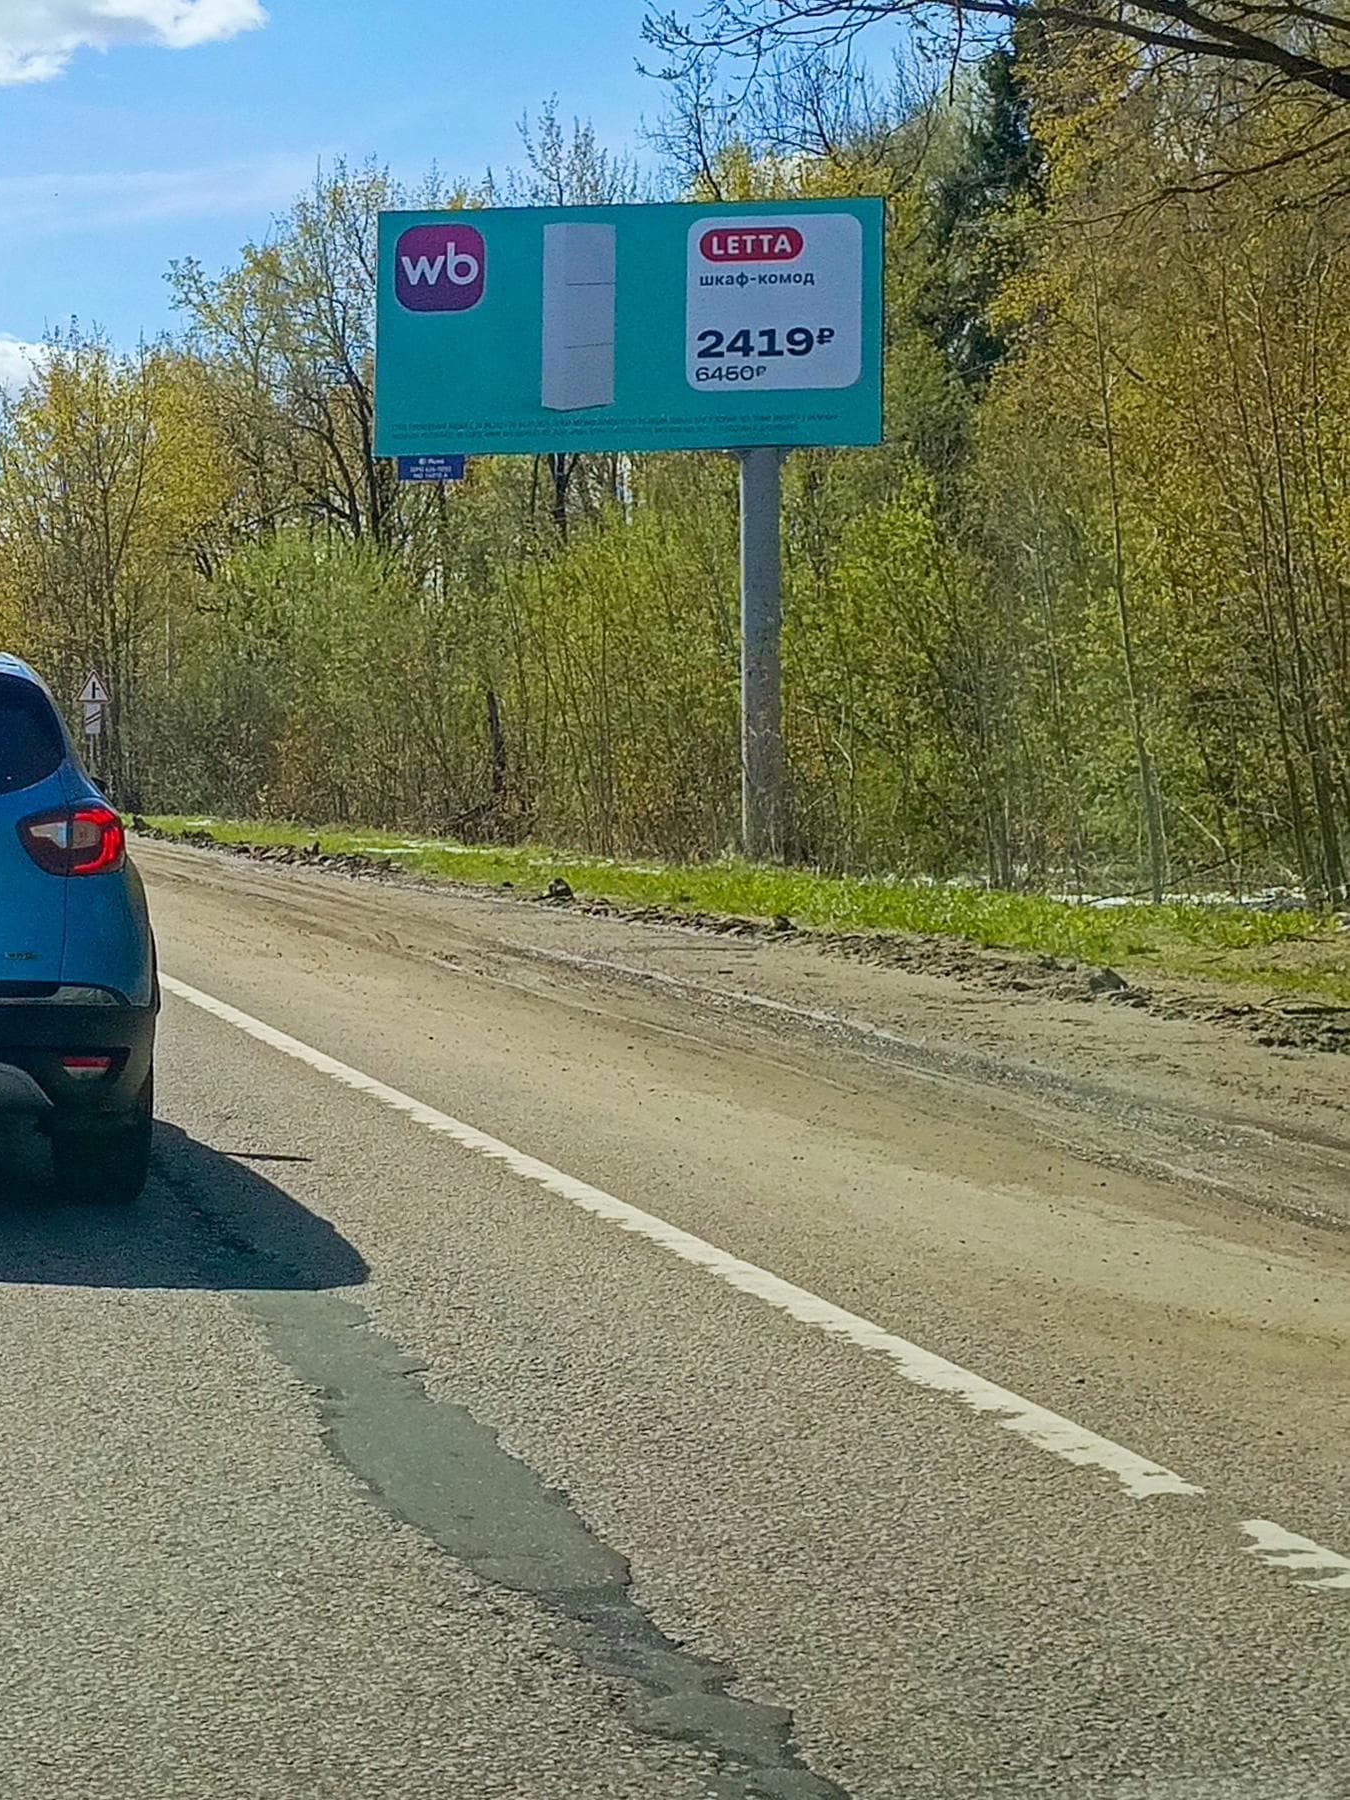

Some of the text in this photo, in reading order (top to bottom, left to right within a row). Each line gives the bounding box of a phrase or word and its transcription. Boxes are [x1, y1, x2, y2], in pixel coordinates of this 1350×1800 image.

[712, 234, 792, 255] LETTA
[401, 242, 479, 286] wb
[700, 272, 815, 288] шкаф-комод
